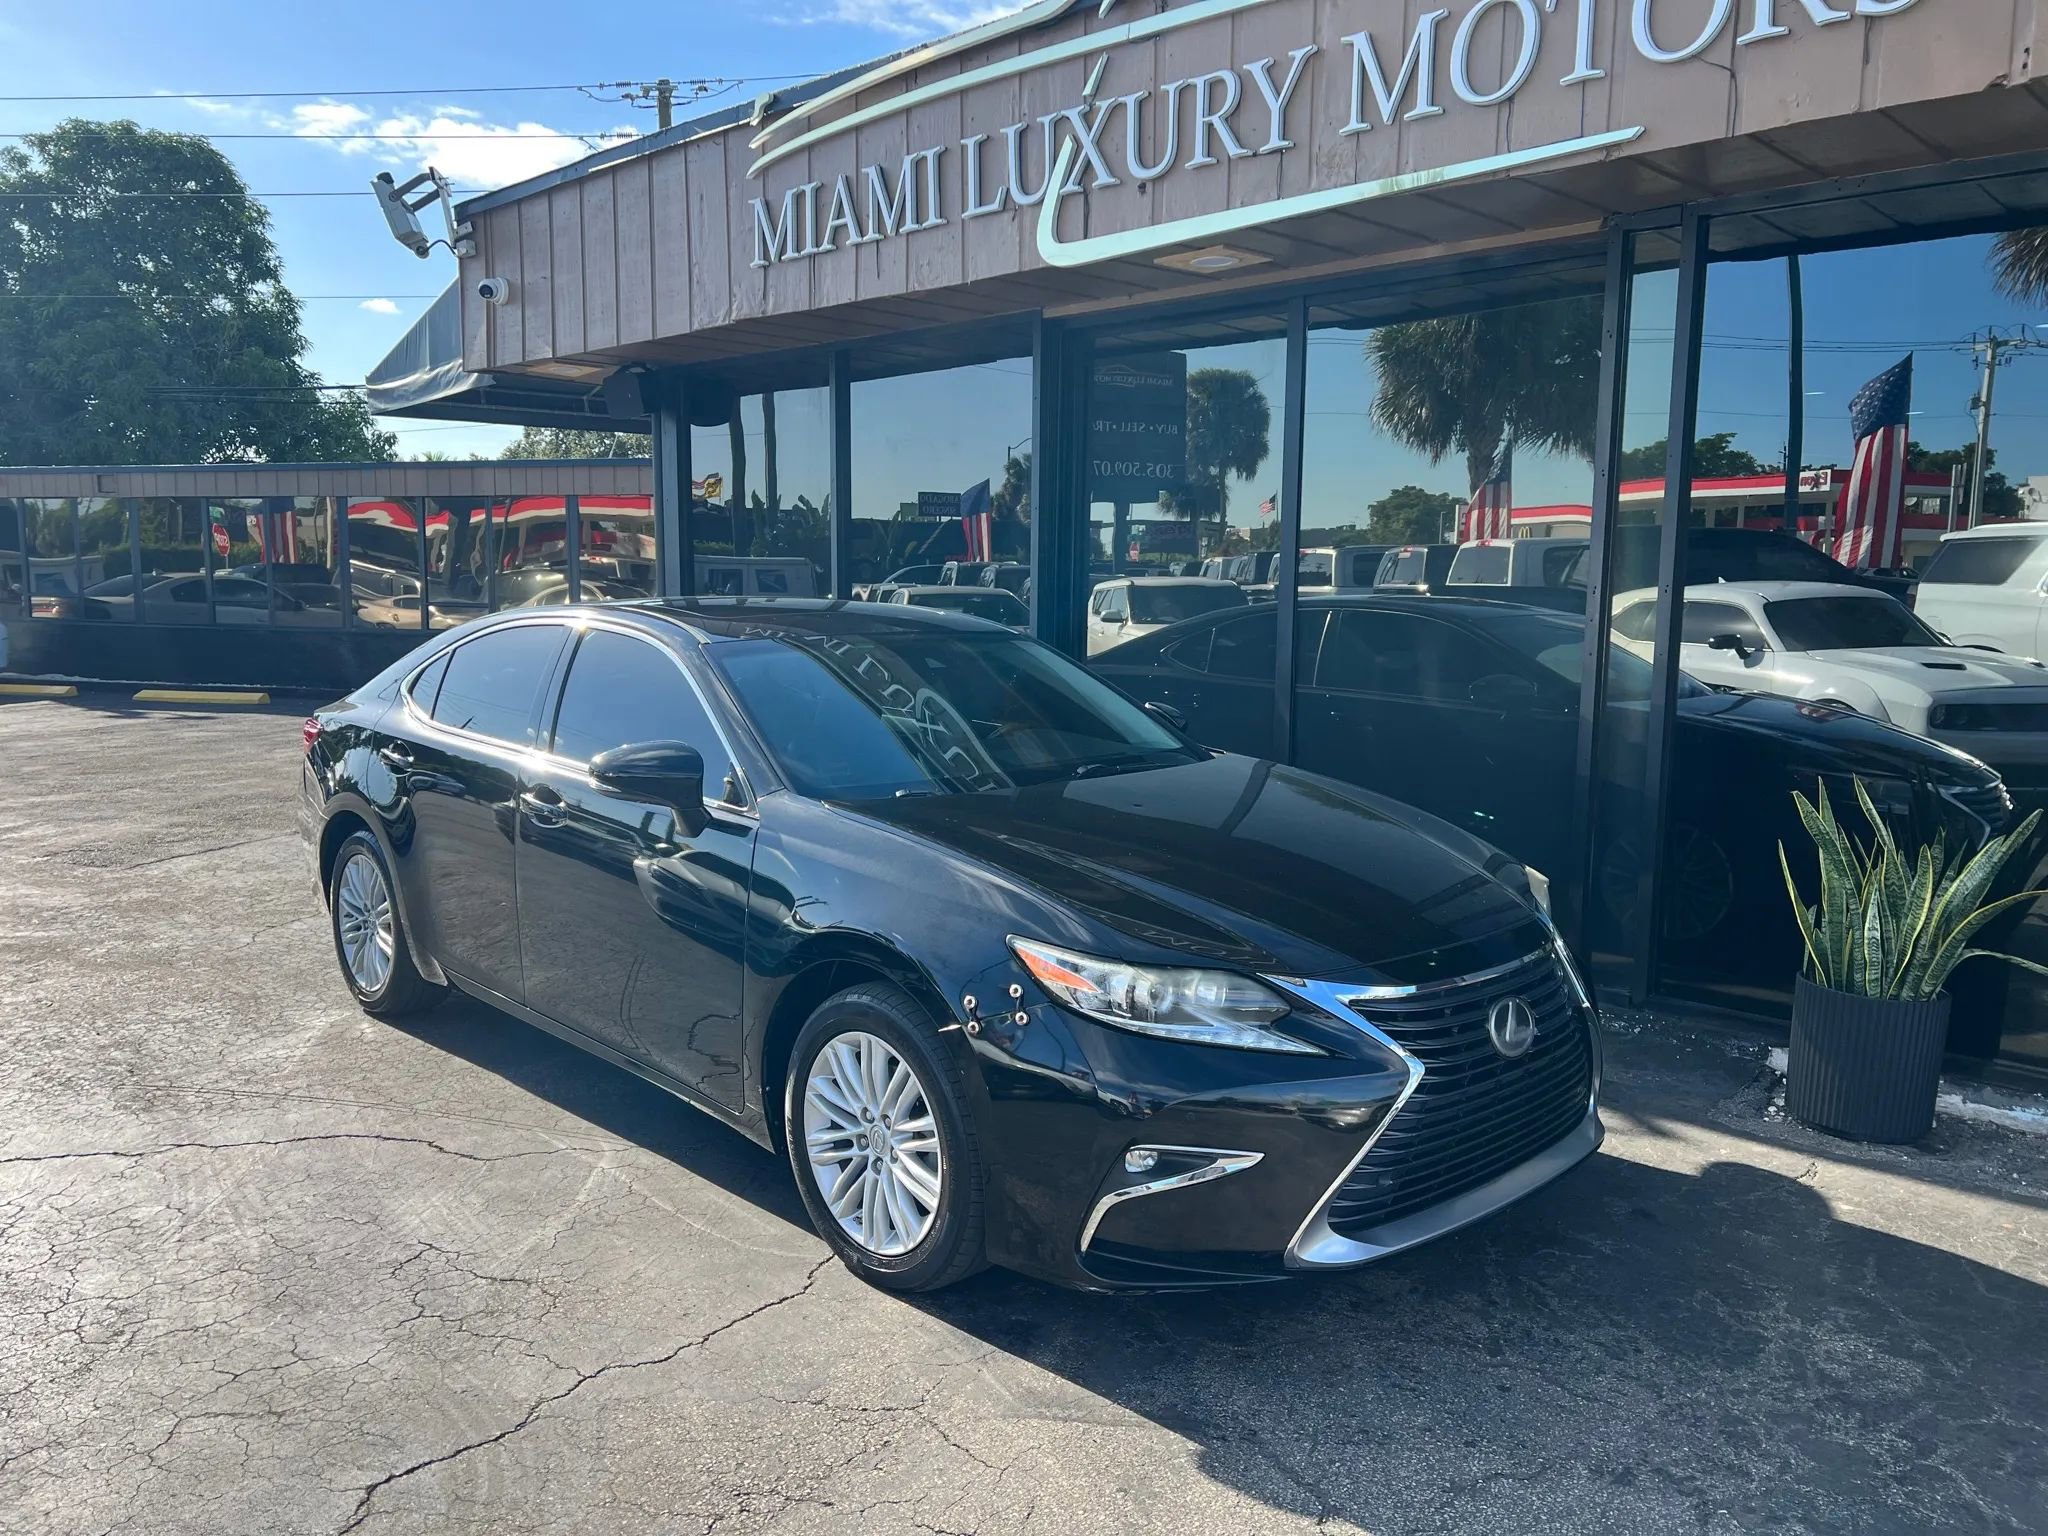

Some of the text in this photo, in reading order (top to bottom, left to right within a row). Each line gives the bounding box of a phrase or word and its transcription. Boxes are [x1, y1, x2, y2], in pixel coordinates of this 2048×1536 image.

[748, 0, 1920, 269] MIAMI LUXURY MOTO
